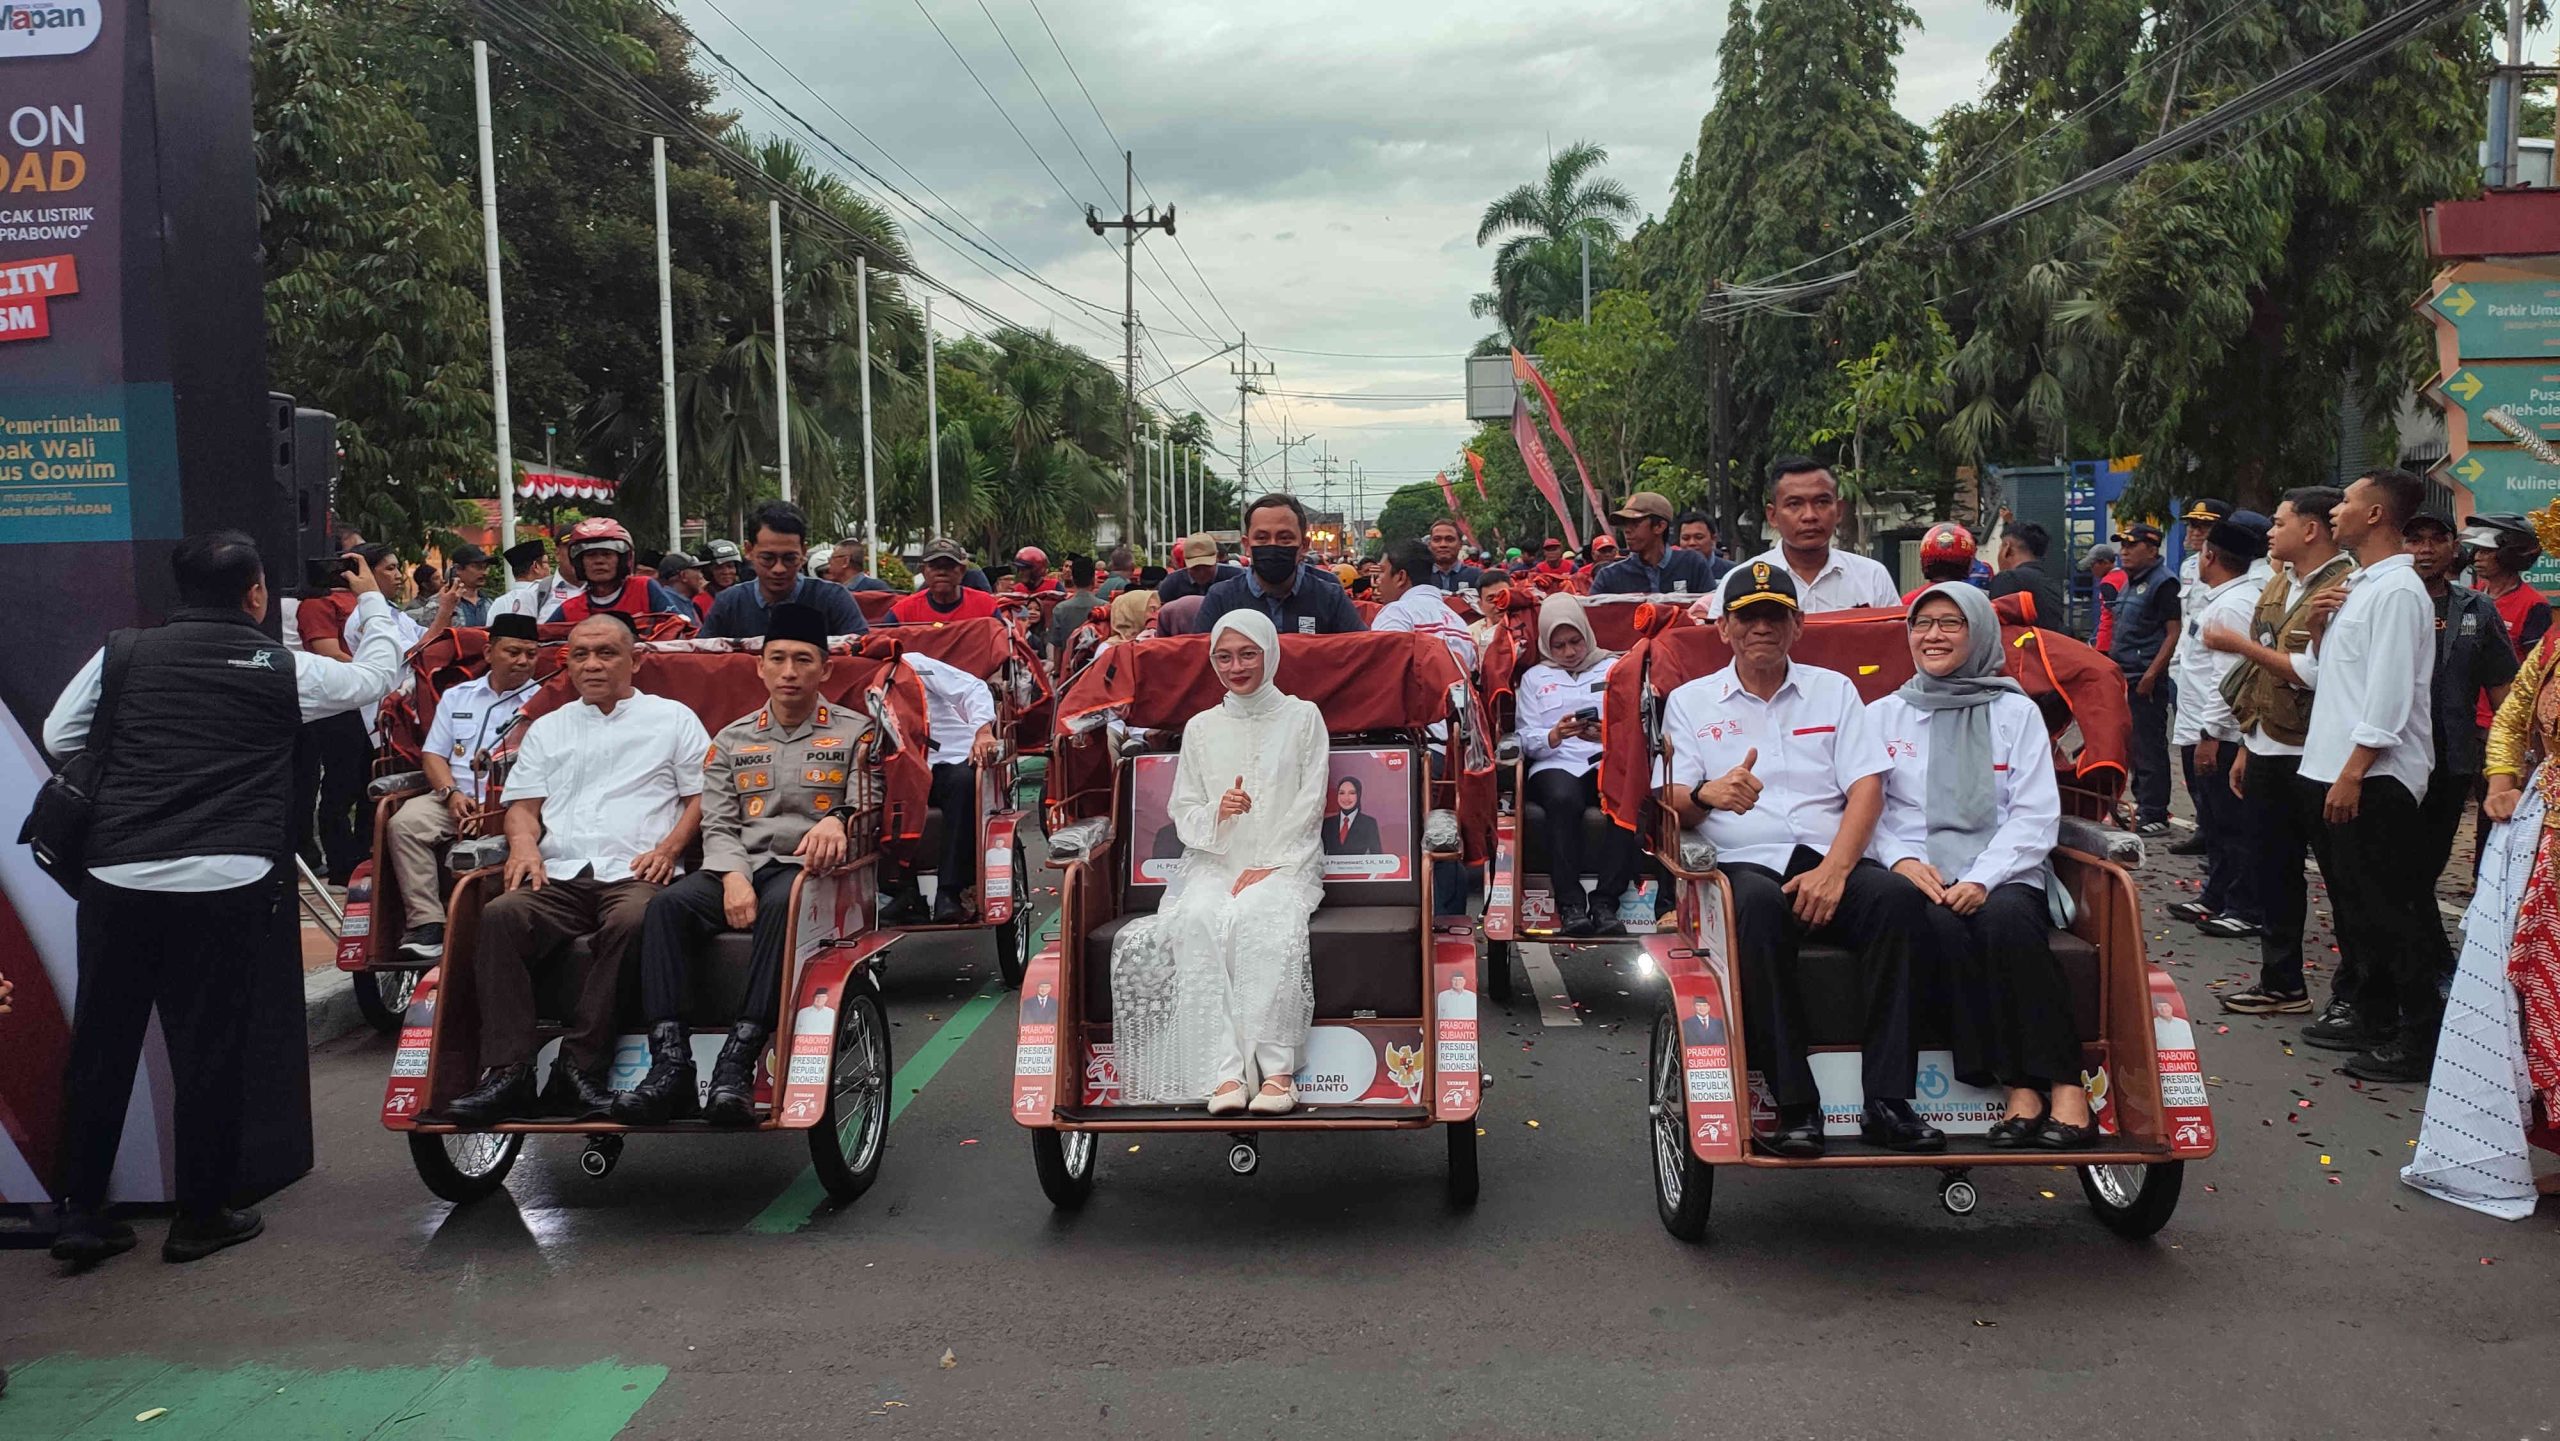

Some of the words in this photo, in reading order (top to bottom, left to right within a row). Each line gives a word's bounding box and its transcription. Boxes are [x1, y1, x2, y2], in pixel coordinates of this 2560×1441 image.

[10, 104, 85, 147] ON
[0, 150, 87, 193] AD
[37, 207, 95, 223] LISTRIK
[2488, 304, 2527, 317] Parkir
[41, 438, 95, 458] Wali
[30, 460, 116, 480] Qowim
[0, 506, 22, 517] ota
[64, 503, 113, 515] MAPAN
[807, 751, 845, 761] POLRI
[1020, 1025, 1055, 1035] PRABOWO
[1439, 1020, 1475, 1030] PRABOWO
[1020, 1035, 1054, 1044] SUBIANTO
[1439, 1030, 1475, 1040] SUBIANTO
[1019, 1046, 1053, 1055] PRESIDEN
[1439, 1042, 1476, 1051] PRESIDEN
[1440, 1052, 1476, 1061] REPUBLIK
[1686, 1047, 1726, 1057] PRABOWO
[792, 1057, 827, 1065] PRESIDEN
[1018, 1056, 1052, 1065] REPUBLIK
[1688, 1058, 1727, 1068] SUBIANTO
[791, 1066, 825, 1074] REPUBLIK
[1017, 1066, 1052, 1074] INDONESIA
[1439, 1062, 1477, 1071] INDONESIA
[2159, 1062, 2197, 1072] SUBIANTO
[1316, 1074, 1345, 1084] DARI
[1690, 1070, 1728, 1079] PRESIDEN
[2160, 1074, 2200, 1084] PRESIDEN
[1691, 1081, 1730, 1091] REPUBLIK
[2163, 1086, 2204, 1095] REPUBLIK
[1690, 1092, 1732, 1101] INDONESIA
[2163, 1097, 2208, 1106] INDONESIA
[1935, 1102, 1983, 1111] LISTRIK
